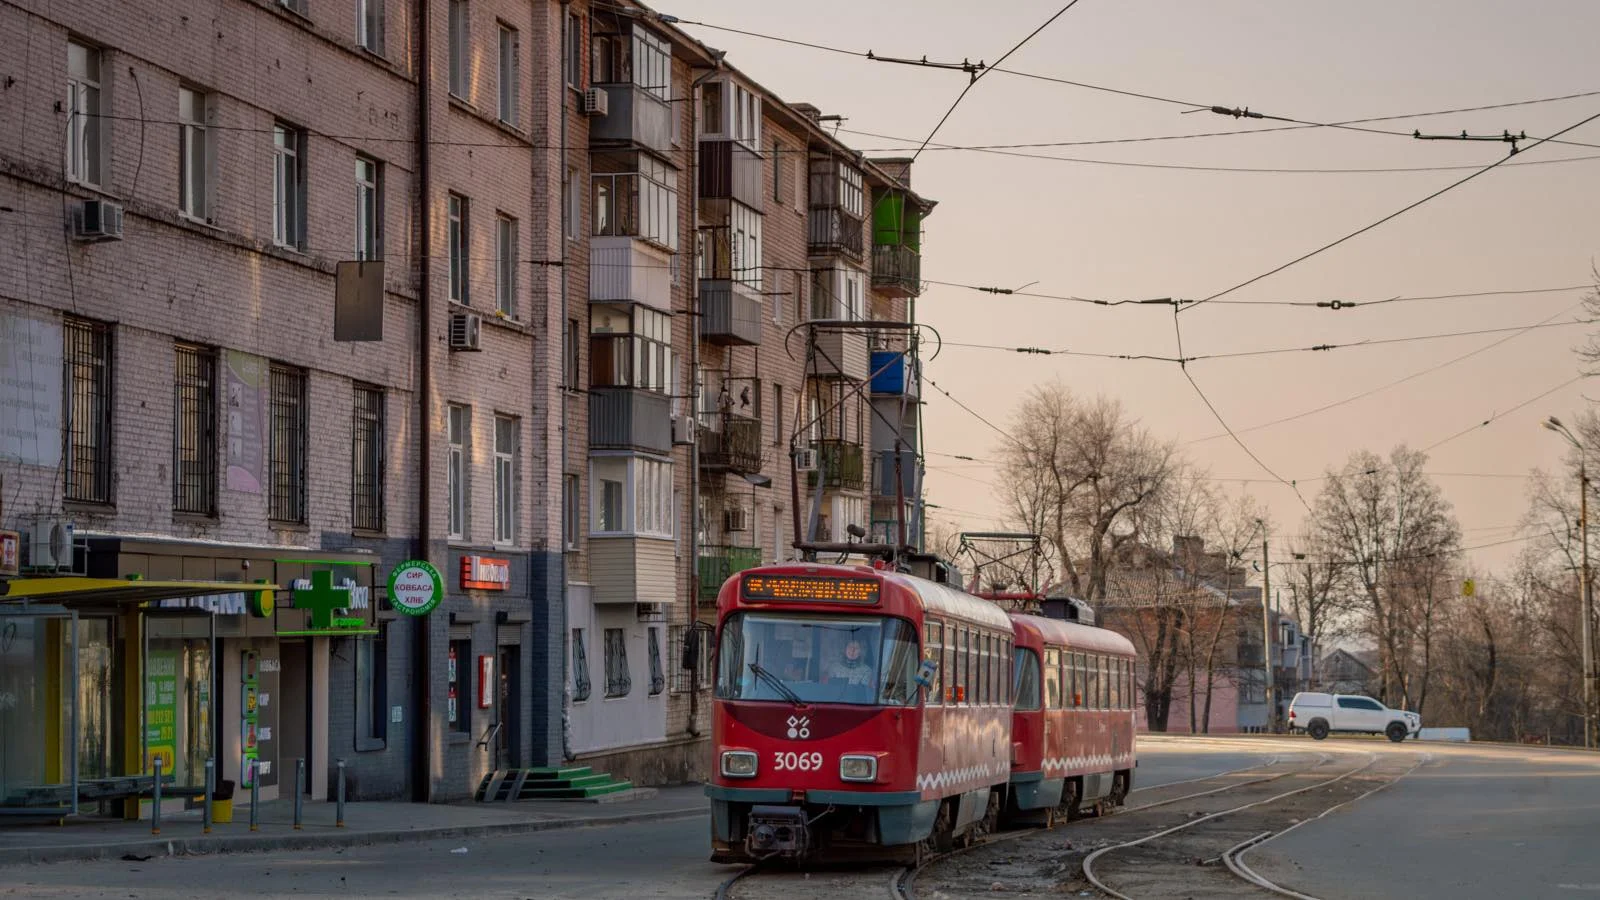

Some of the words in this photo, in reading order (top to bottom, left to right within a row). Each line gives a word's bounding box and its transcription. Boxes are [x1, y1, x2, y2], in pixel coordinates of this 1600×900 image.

[392, 561, 437, 577] ФЕРМЕРСЬКА
[395, 583, 433, 592] КОВБАСА
[404, 596, 425, 604] ХЛІБ
[774, 751, 824, 771] 3069
